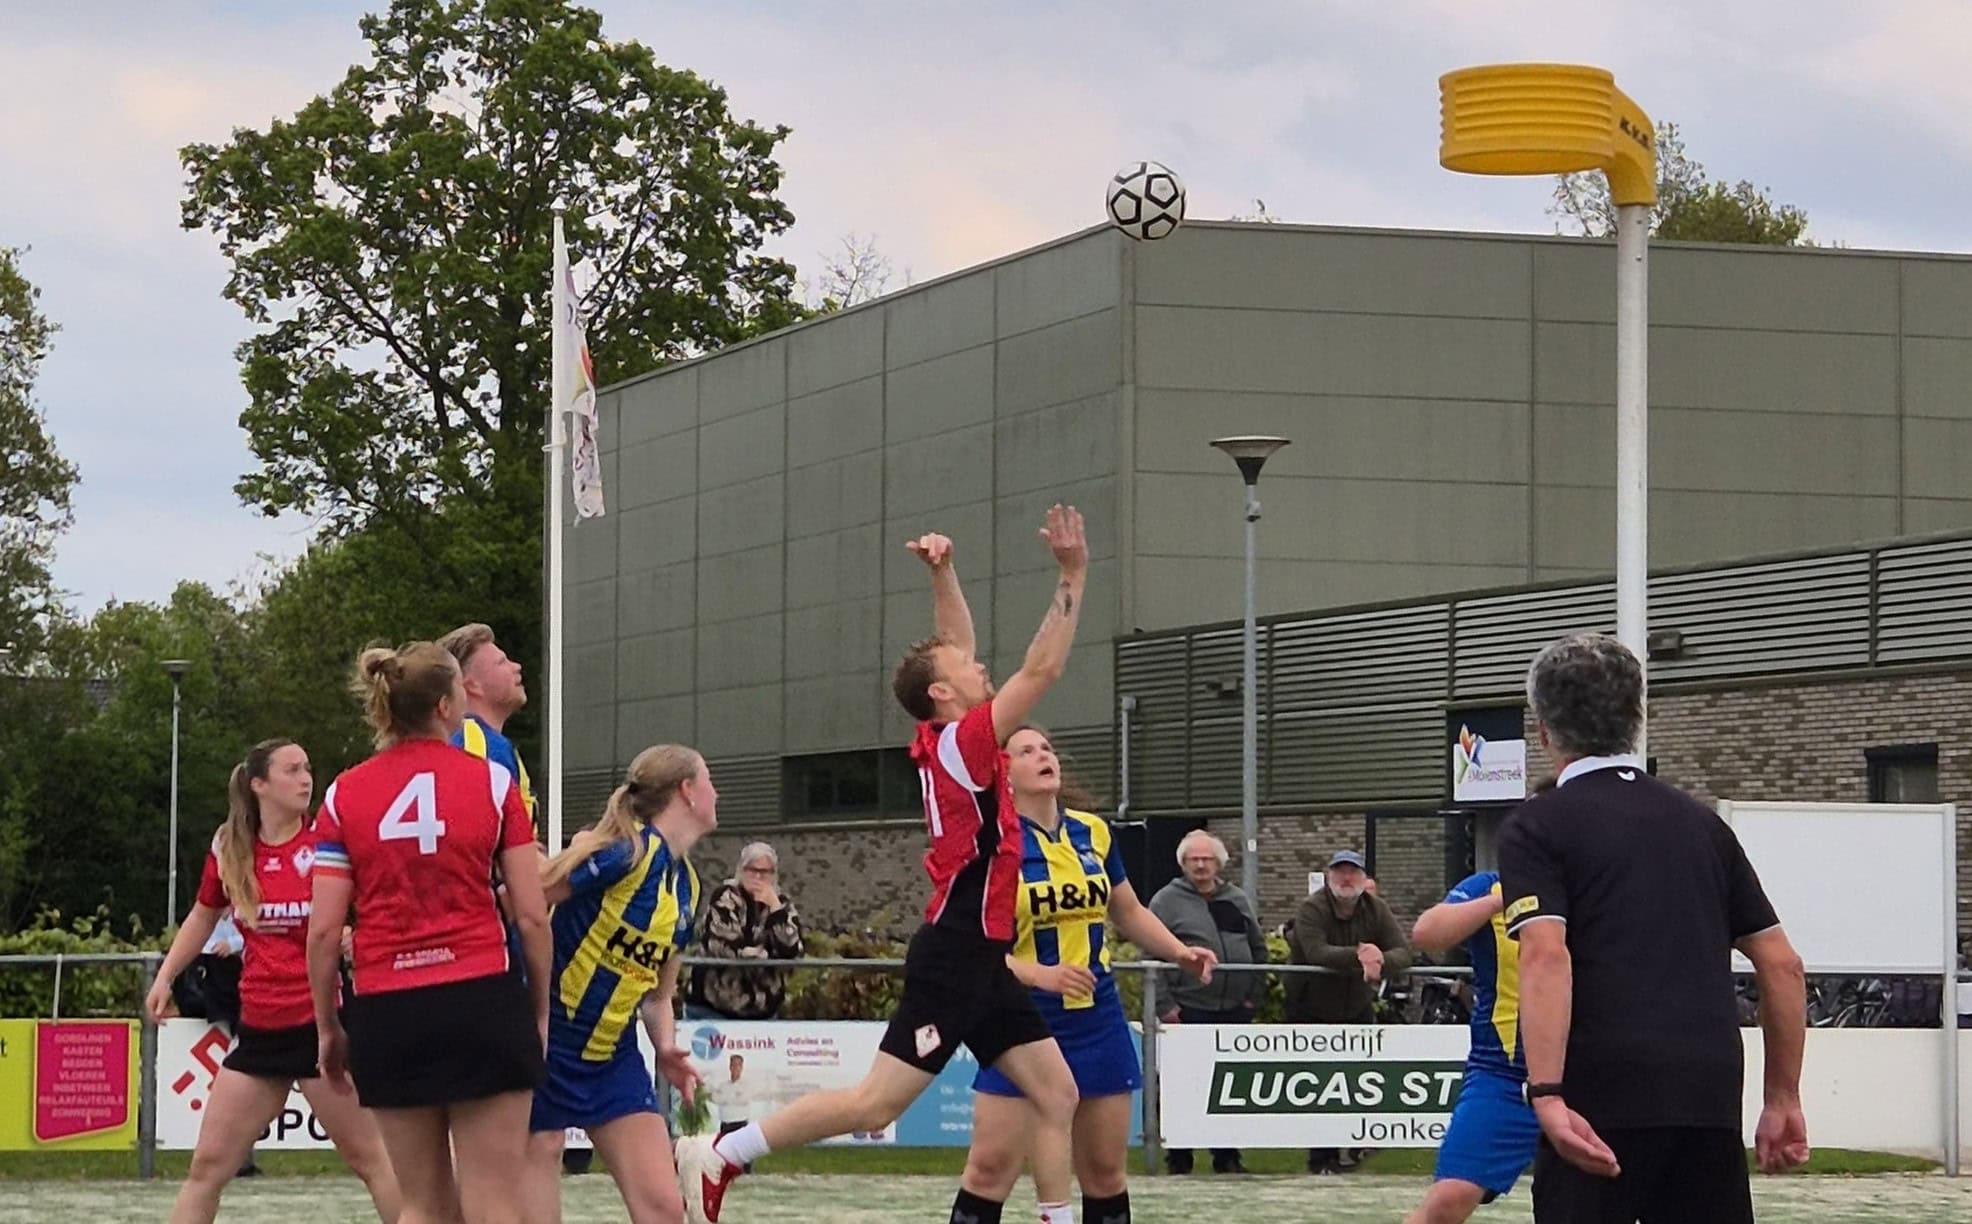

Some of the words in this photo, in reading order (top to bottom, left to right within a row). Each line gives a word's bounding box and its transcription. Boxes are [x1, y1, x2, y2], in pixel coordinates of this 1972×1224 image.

[378, 771, 446, 855] 4
[1028, 878, 1109, 917] H&N
[708, 1033, 777, 1050] Wassink
[1214, 1028, 1386, 1058] Loonbedrijf
[1218, 1071, 1386, 1107] LUCAS
[1398, 1071, 1463, 1107] ST
[1350, 1116, 1446, 1142] Jonke
